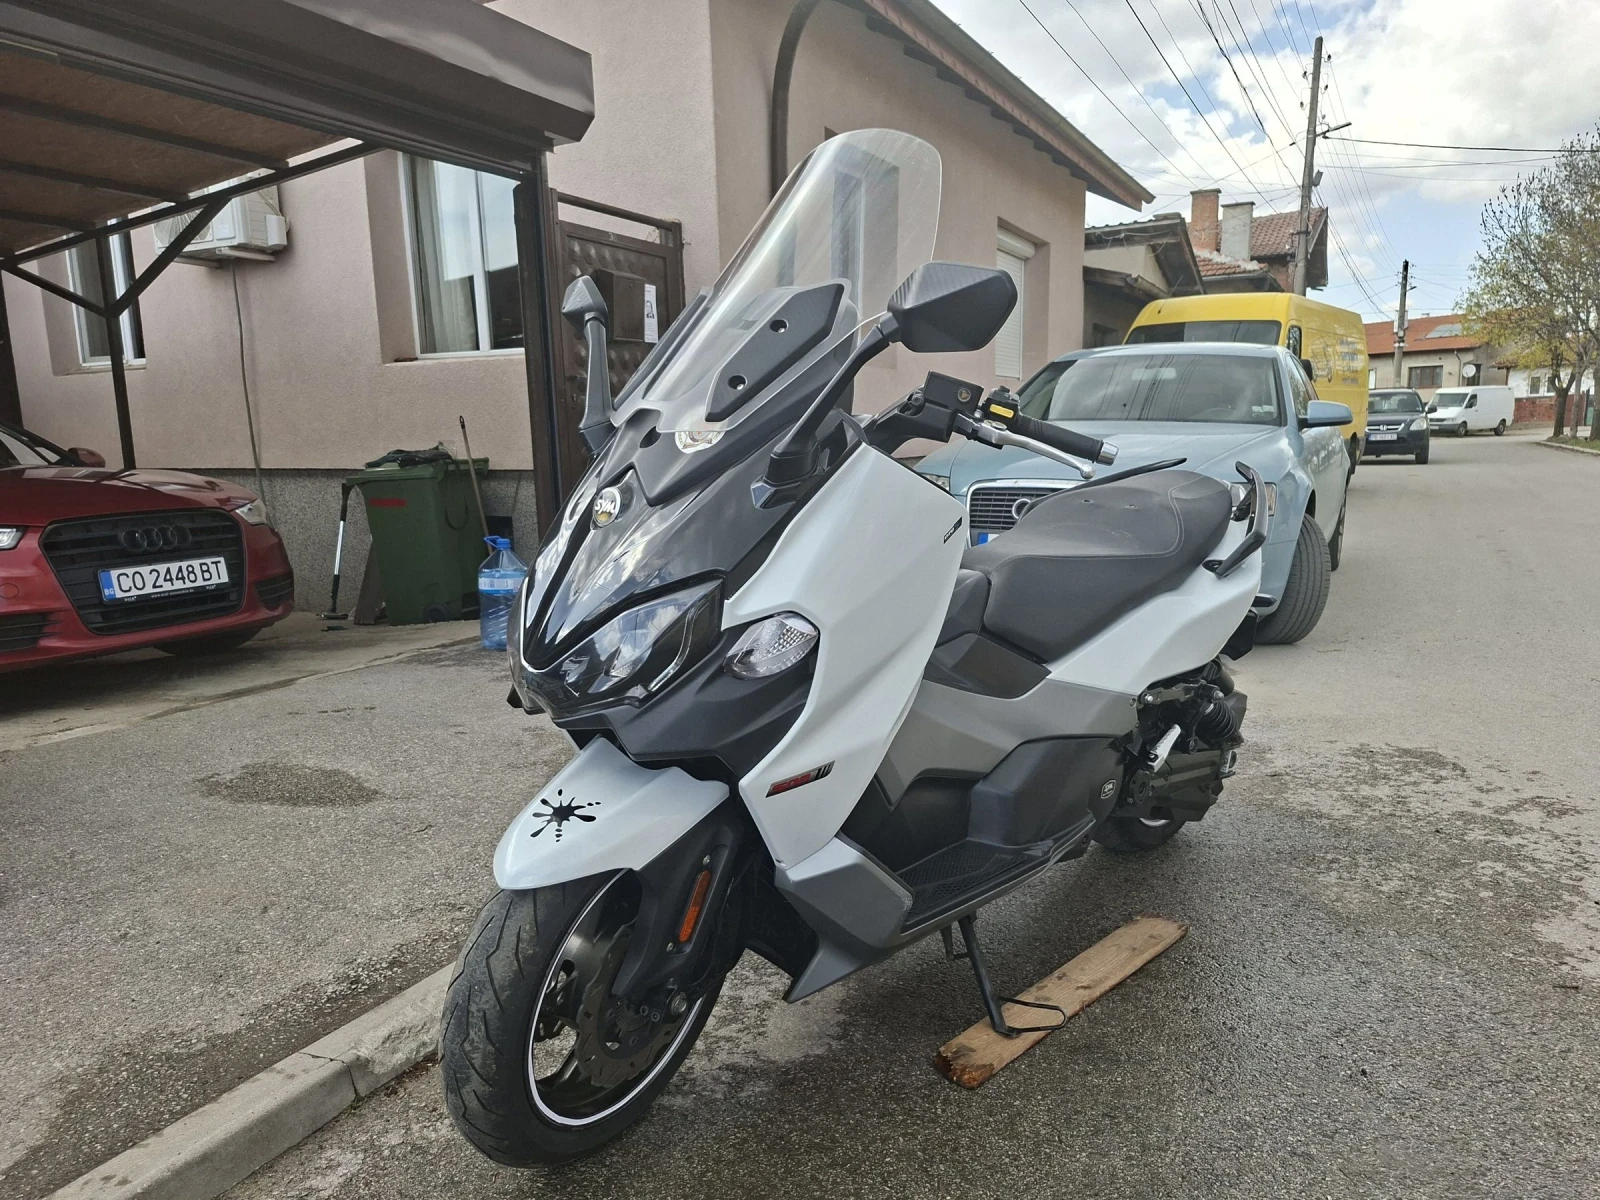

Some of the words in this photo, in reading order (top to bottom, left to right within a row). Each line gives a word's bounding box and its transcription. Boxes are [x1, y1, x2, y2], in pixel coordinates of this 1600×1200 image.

[594, 499, 615, 514] SYM
[149, 564, 198, 589] 2448
[199, 560, 222, 582] BT
[104, 588, 115, 596] BG
